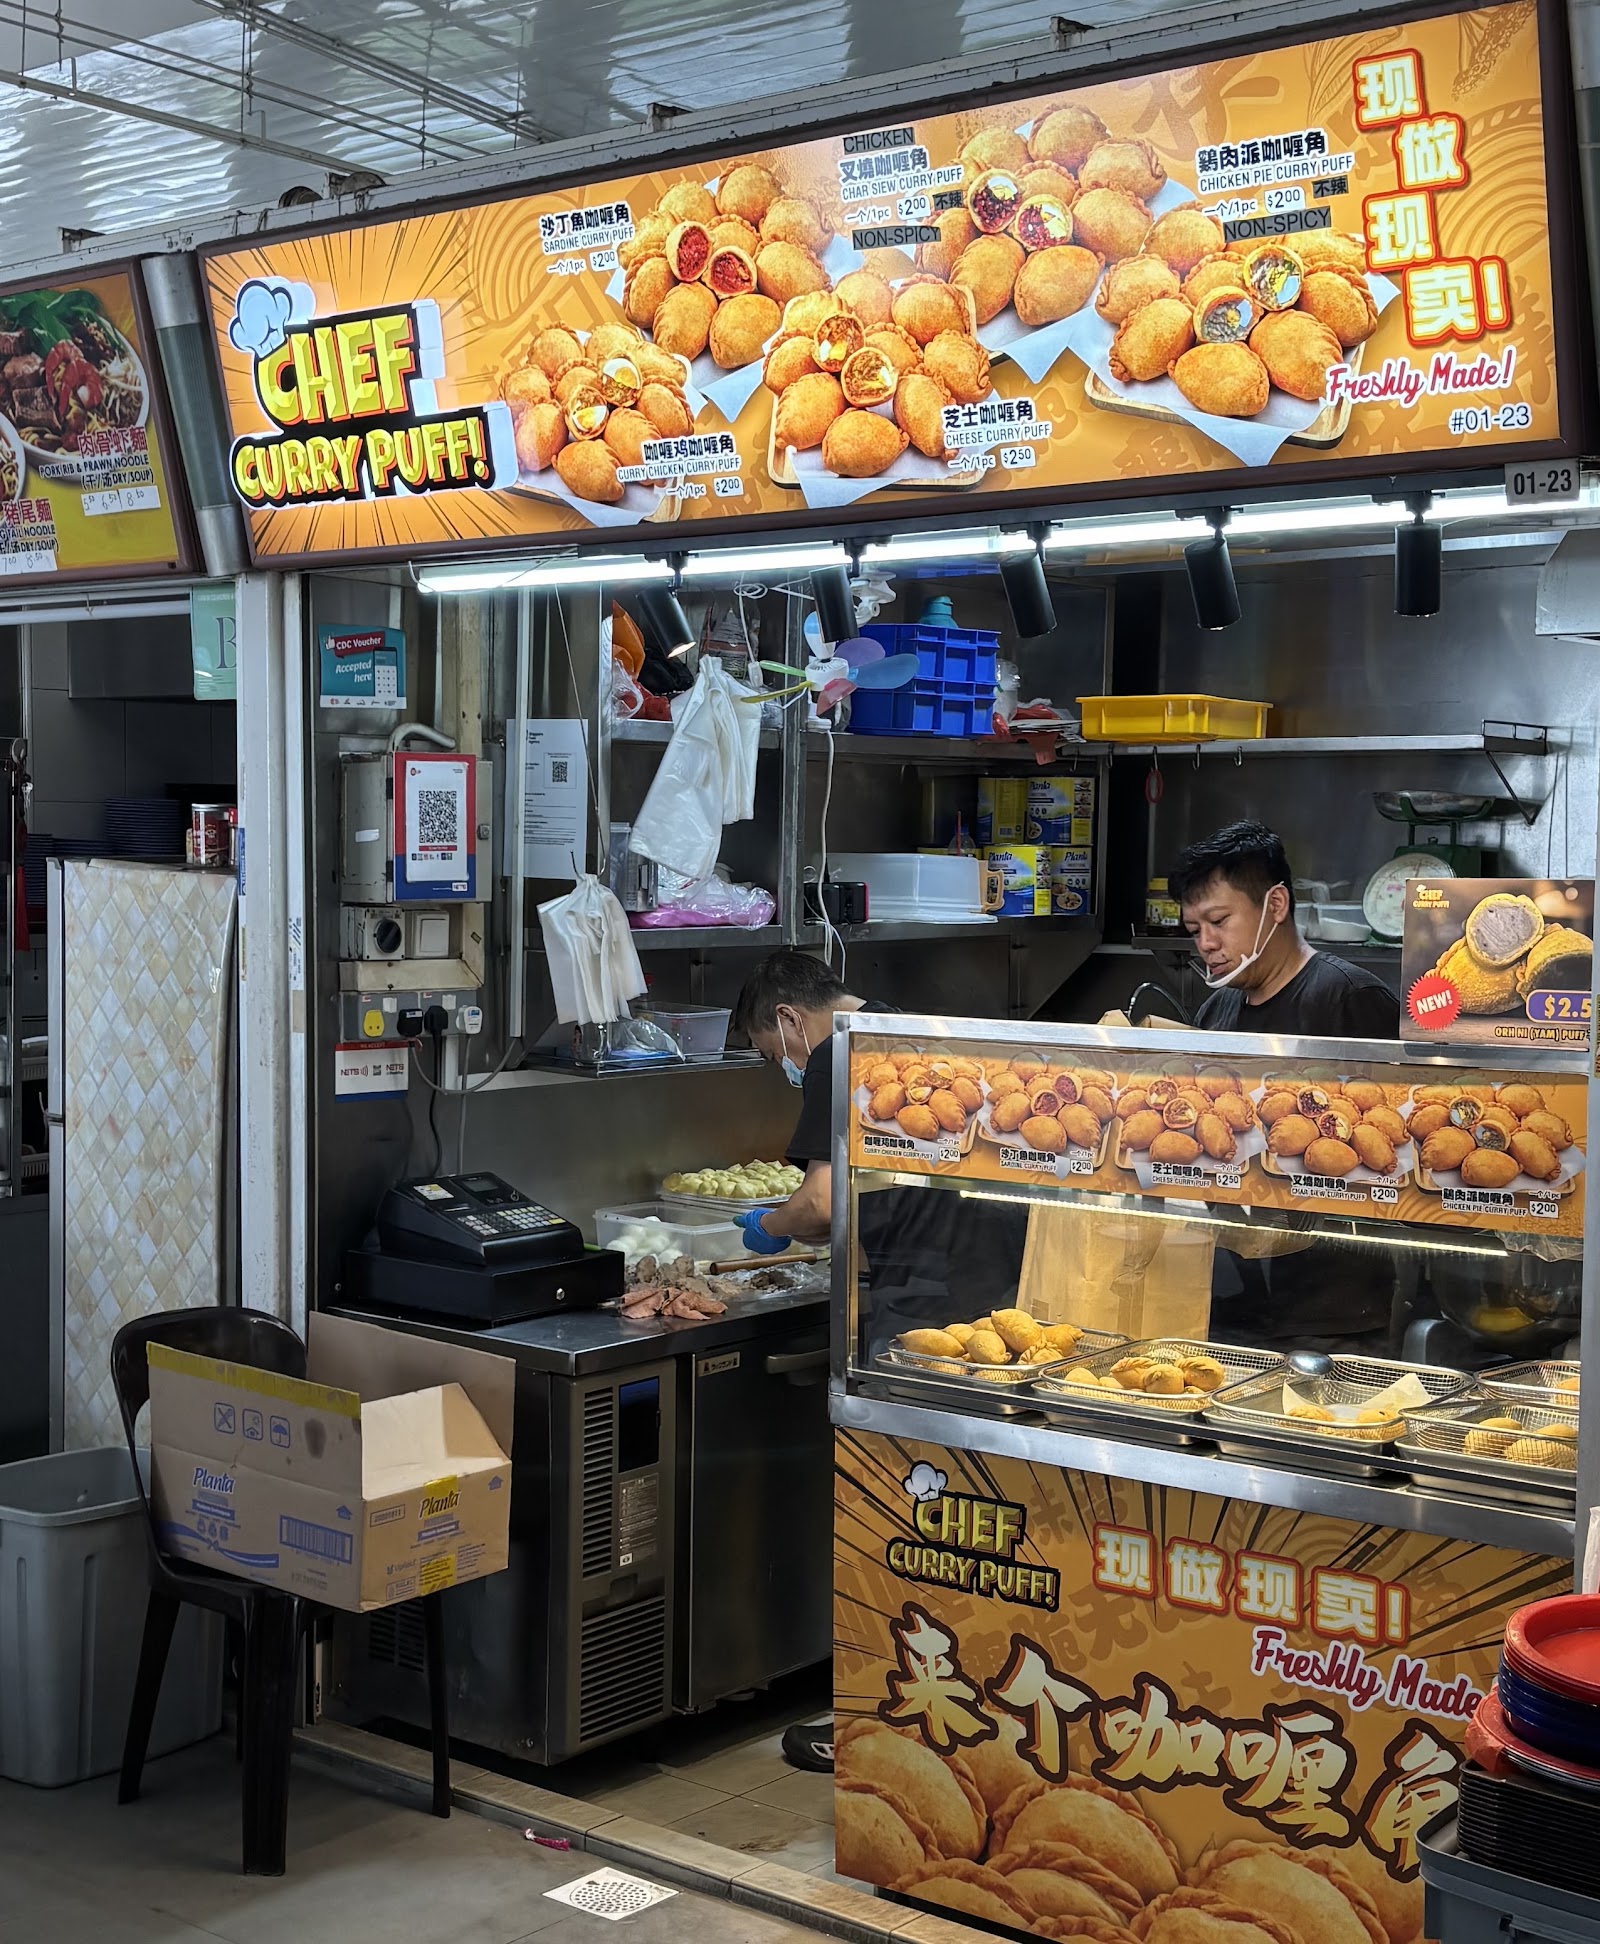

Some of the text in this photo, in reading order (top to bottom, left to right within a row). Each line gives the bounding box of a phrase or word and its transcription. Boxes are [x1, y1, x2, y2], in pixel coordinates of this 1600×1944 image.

[844, 128, 914, 153] CHICKEN
[840, 148, 928, 183] 叉燒咖喱角
[1200, 156, 1353, 192] CHICKEN PIE CURRY PUFF
[843, 167, 962, 200] CHAR SIEW CURRY PUFF
[1314, 177, 1347, 197] 不辣
[1356, 54, 1507, 338] 现做现卖!
[934, 191, 963, 209] 不辣
[541, 204, 629, 237] 沙丁魚咖喱角
[1224, 210, 1330, 242] NON-SPICY
[544, 227, 634, 253] SARDINE CURRY PUFF
[853, 227, 939, 249] NON-SPICY
[258, 314, 415, 425] CHEF
[1328, 351, 1513, 405] Freshly Made!
[944, 401, 1033, 429] 芝士咖喱角
[1451, 407, 1529, 432] #01-23
[644, 434, 734, 461] 咖喱鸡咖喱角
[946, 424, 1050, 446] CHEESE CURRY PUFF
[40, 454, 149, 477] PORK RIB & PRAWN NOODLE
[235, 417, 489, 500] CURRY PUFF!
[618, 457, 740, 480] CURRY CHICKEN CURRY PUFF
[1513, 469, 1571, 496] 01-23
[24, 524, 56, 537] NOODLE
[336, 641, 352, 650] CDC
[335, 659, 372, 674] Accepted
[354, 673, 372, 683] here
[1419, 889, 1443, 901] CHEF
[1416, 990, 1453, 1015] NEW!
[1544, 994, 1591, 1019] $2.5
[1495, 1026, 1516, 1038] ORH
[1517, 1027, 1528, 1038] NI
[1530, 1027, 1559, 1041] (YAM)
[1562, 1029, 1585, 1041] PUFF
[1000, 1160, 1057, 1172] SARDINE CURRY PUFF
[1152, 1176, 1211, 1187] CHEESE CURRY PUFF
[1327, 1191, 1348, 1199] CURRY
[1443, 1202, 1471, 1211] CHICKEN
[1485, 1206, 1508, 1214] CURRY
[193, 1467, 235, 1493] Planta
[419, 1490, 460, 1519] Planta
[916, 1496, 1023, 1557] CHEF
[889, 1542, 1056, 1607] CURRY PUFF!
[1096, 1526, 1407, 1644] 现做现卖!
[1255, 1630, 1381, 1708] Freshly
